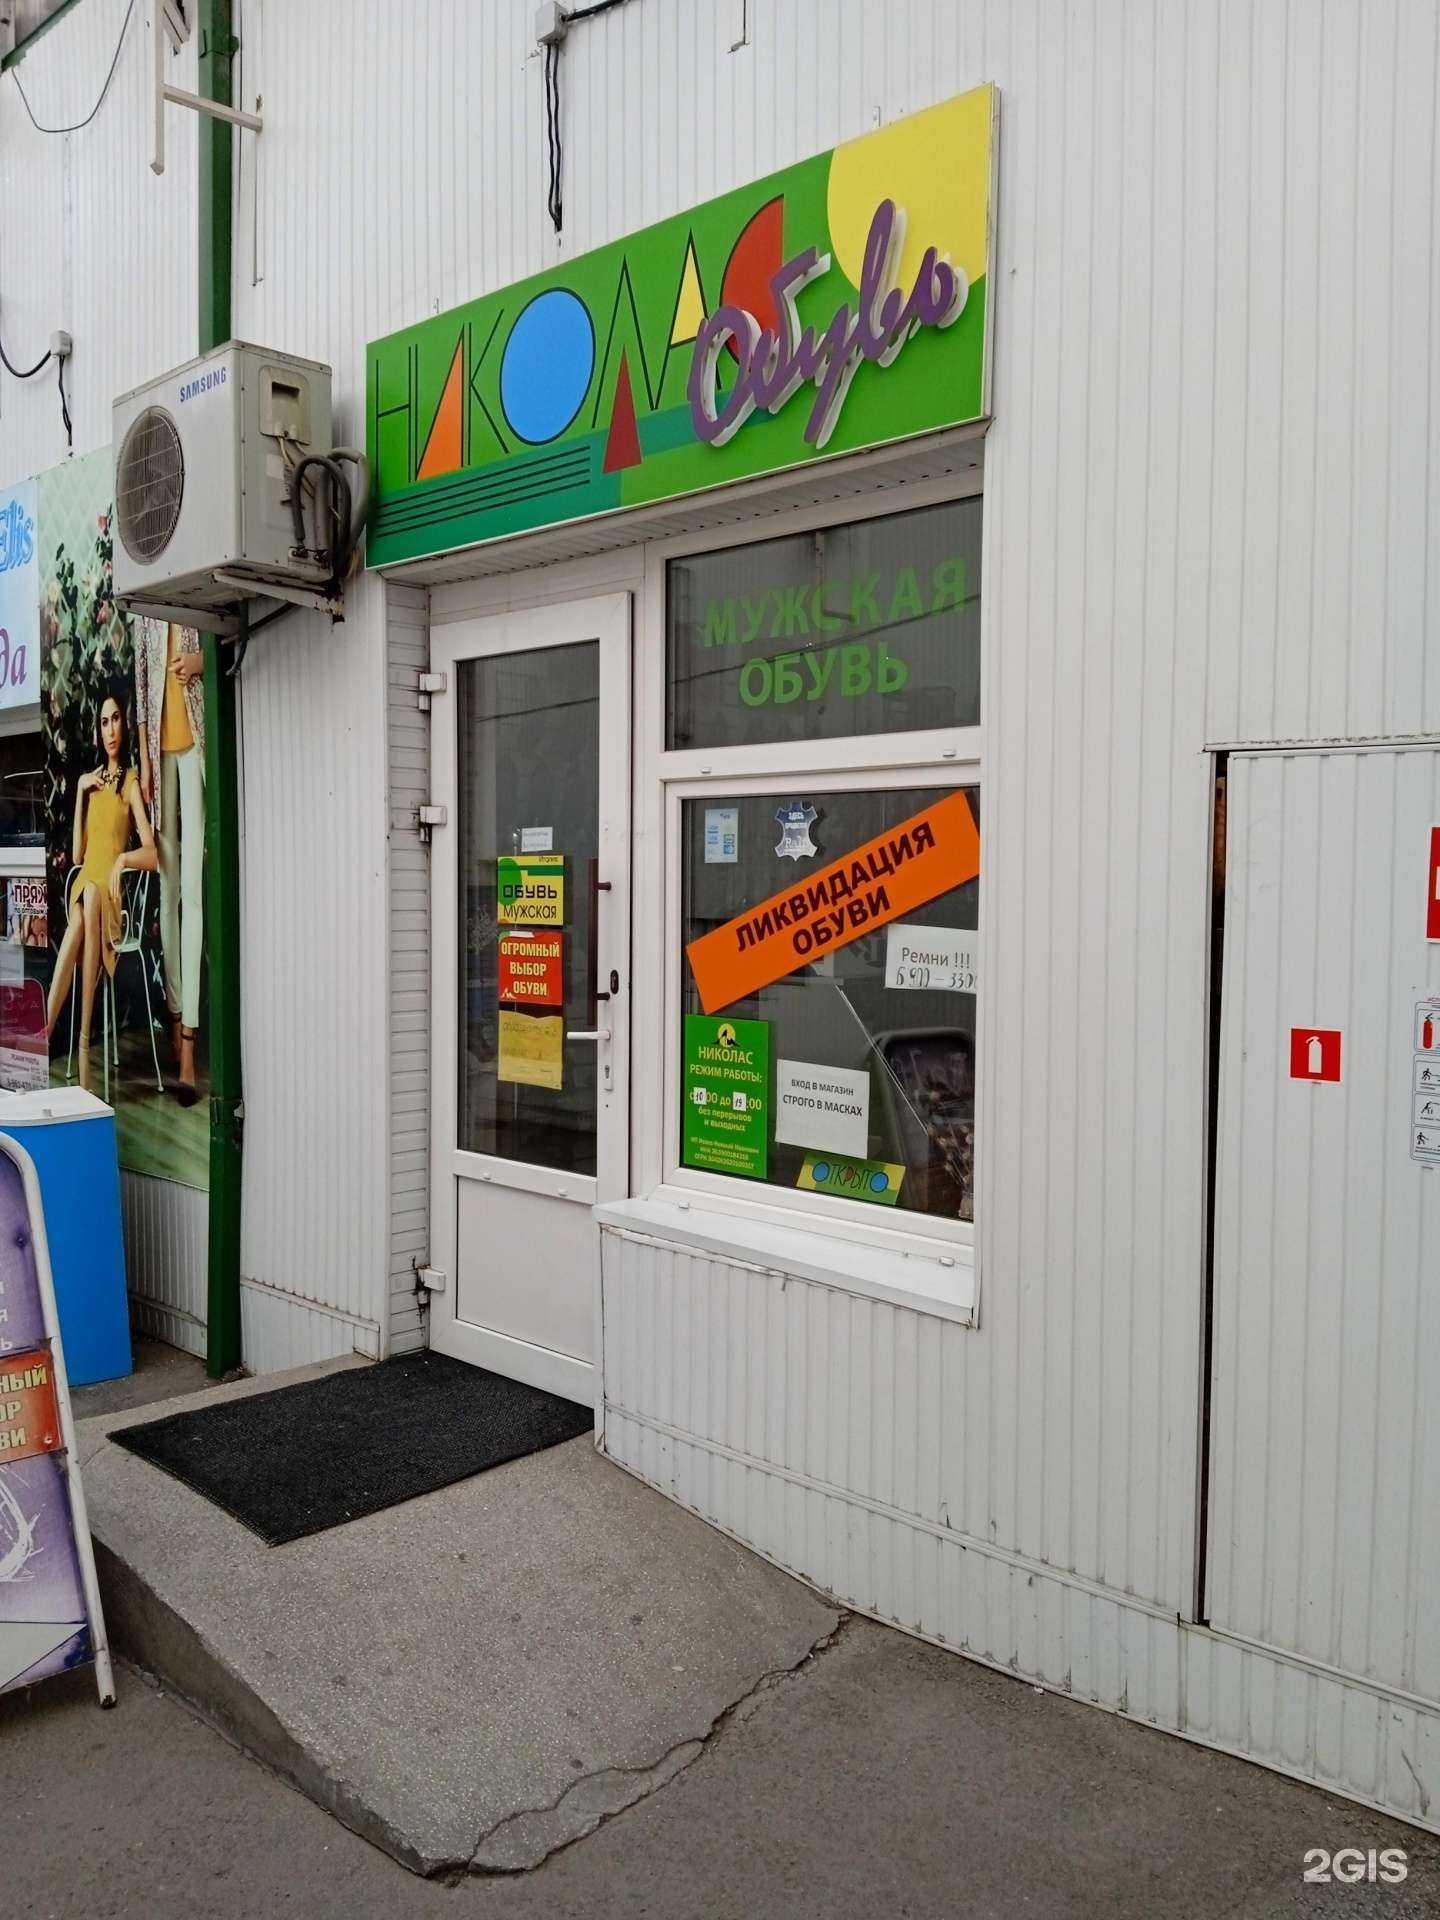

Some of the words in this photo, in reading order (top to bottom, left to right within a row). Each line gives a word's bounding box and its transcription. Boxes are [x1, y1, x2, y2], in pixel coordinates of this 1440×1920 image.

[180, 366, 226, 402] SAMSUNG
[703, 554, 968, 648] МУЖСКАЯ
[738, 641, 911, 707] ОБУВЬ
[503, 884, 558, 899] ОБУВЬ
[735, 821, 936, 952] ЛИКВИДАЦИЯ
[792, 885, 890, 955] ОБУВИ
[501, 941, 560, 957] ОГРОМНЫЙ
[902, 947, 949, 967] Ремни
[509, 961, 547, 976] ВЫБОР
[513, 981, 547, 996] ОБУВИ
[698, 1046, 754, 1065] НИКОЛАС
[689, 1064, 722, 1077] РЕЖИМ
[723, 1068, 762, 1083] РАБОТЫ:
[791, 1078, 811, 1091] ВХОД
[812, 1082, 818, 1090] В
[819, 1084, 854, 1096] МАГАЗИН
[782, 1094, 815, 1110] СТРОГО
[816, 1100, 823, 1110] В
[824, 1101, 863, 1117] МАСКАХ
[812, 1161, 889, 1194] ОТКРЫТО
